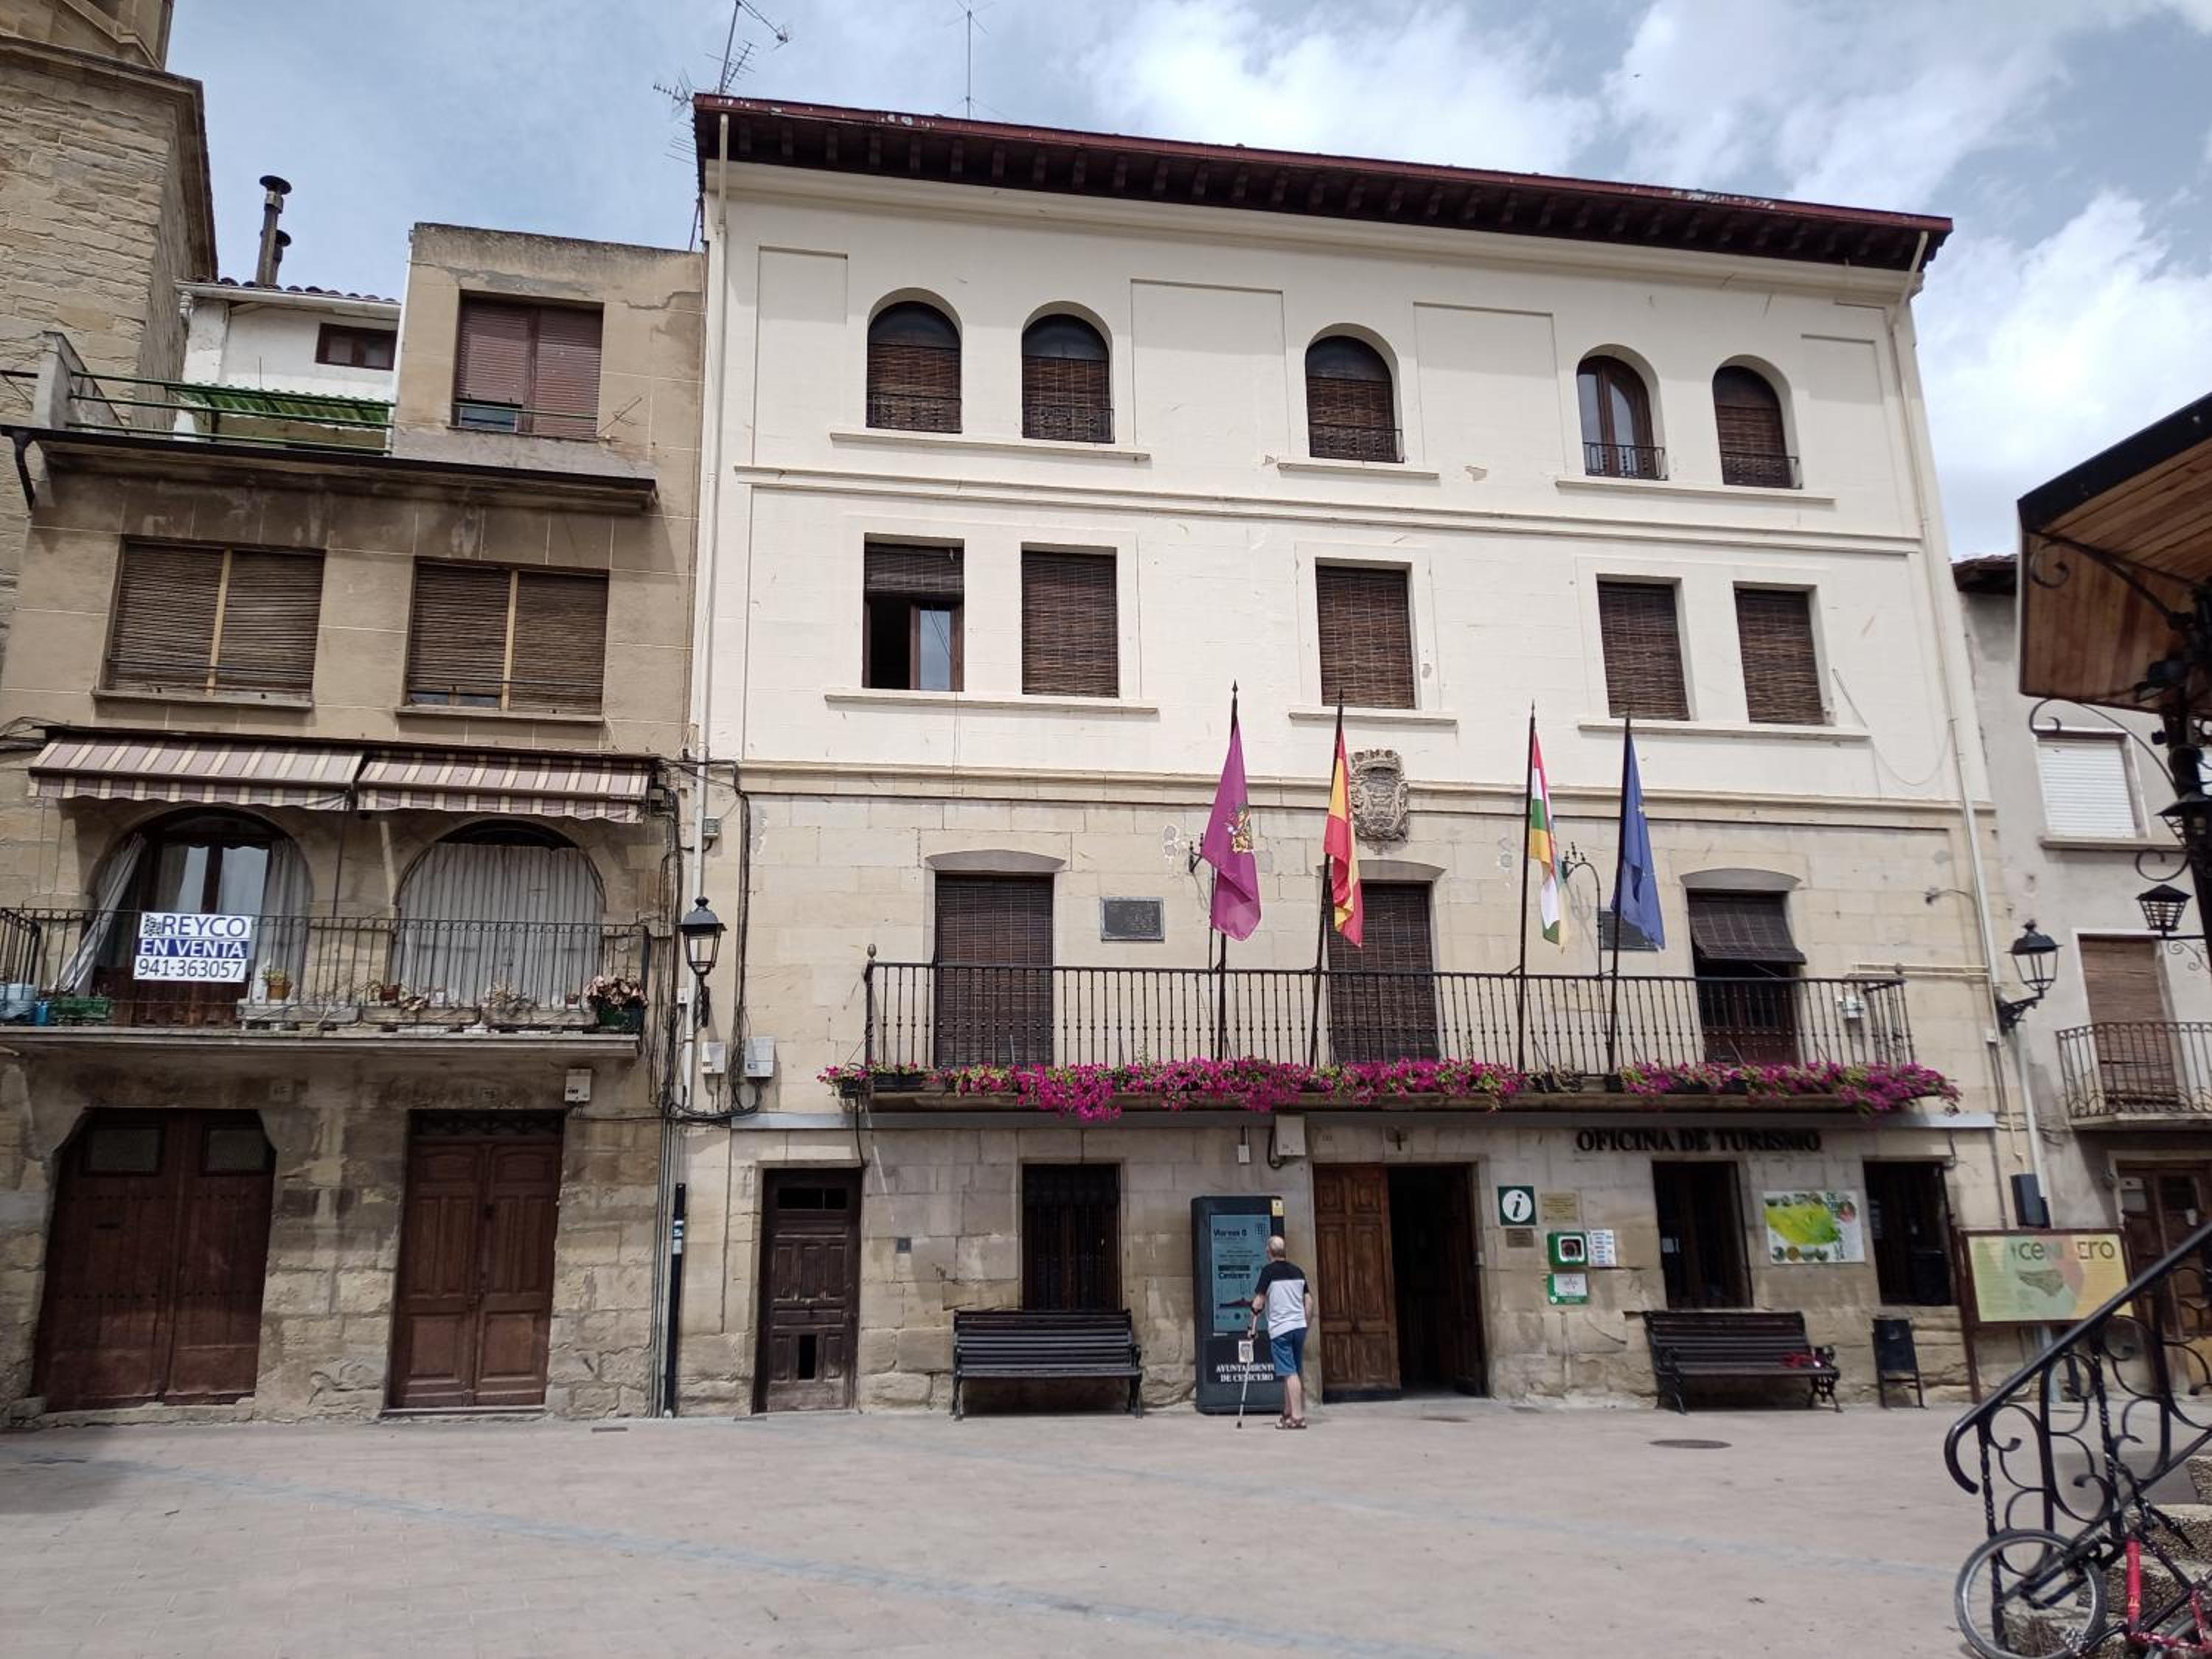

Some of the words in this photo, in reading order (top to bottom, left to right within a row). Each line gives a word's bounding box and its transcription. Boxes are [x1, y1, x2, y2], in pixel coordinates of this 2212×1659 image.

[161, 915, 246, 937] REYCO
[140, 939, 169, 956] EN
[175, 940, 244, 958] VENTA
[1576, 1130, 1675, 1151] OFICINA
[1677, 1130, 1712, 1151] DE
[1715, 1130, 1821, 1151] TURISMO
